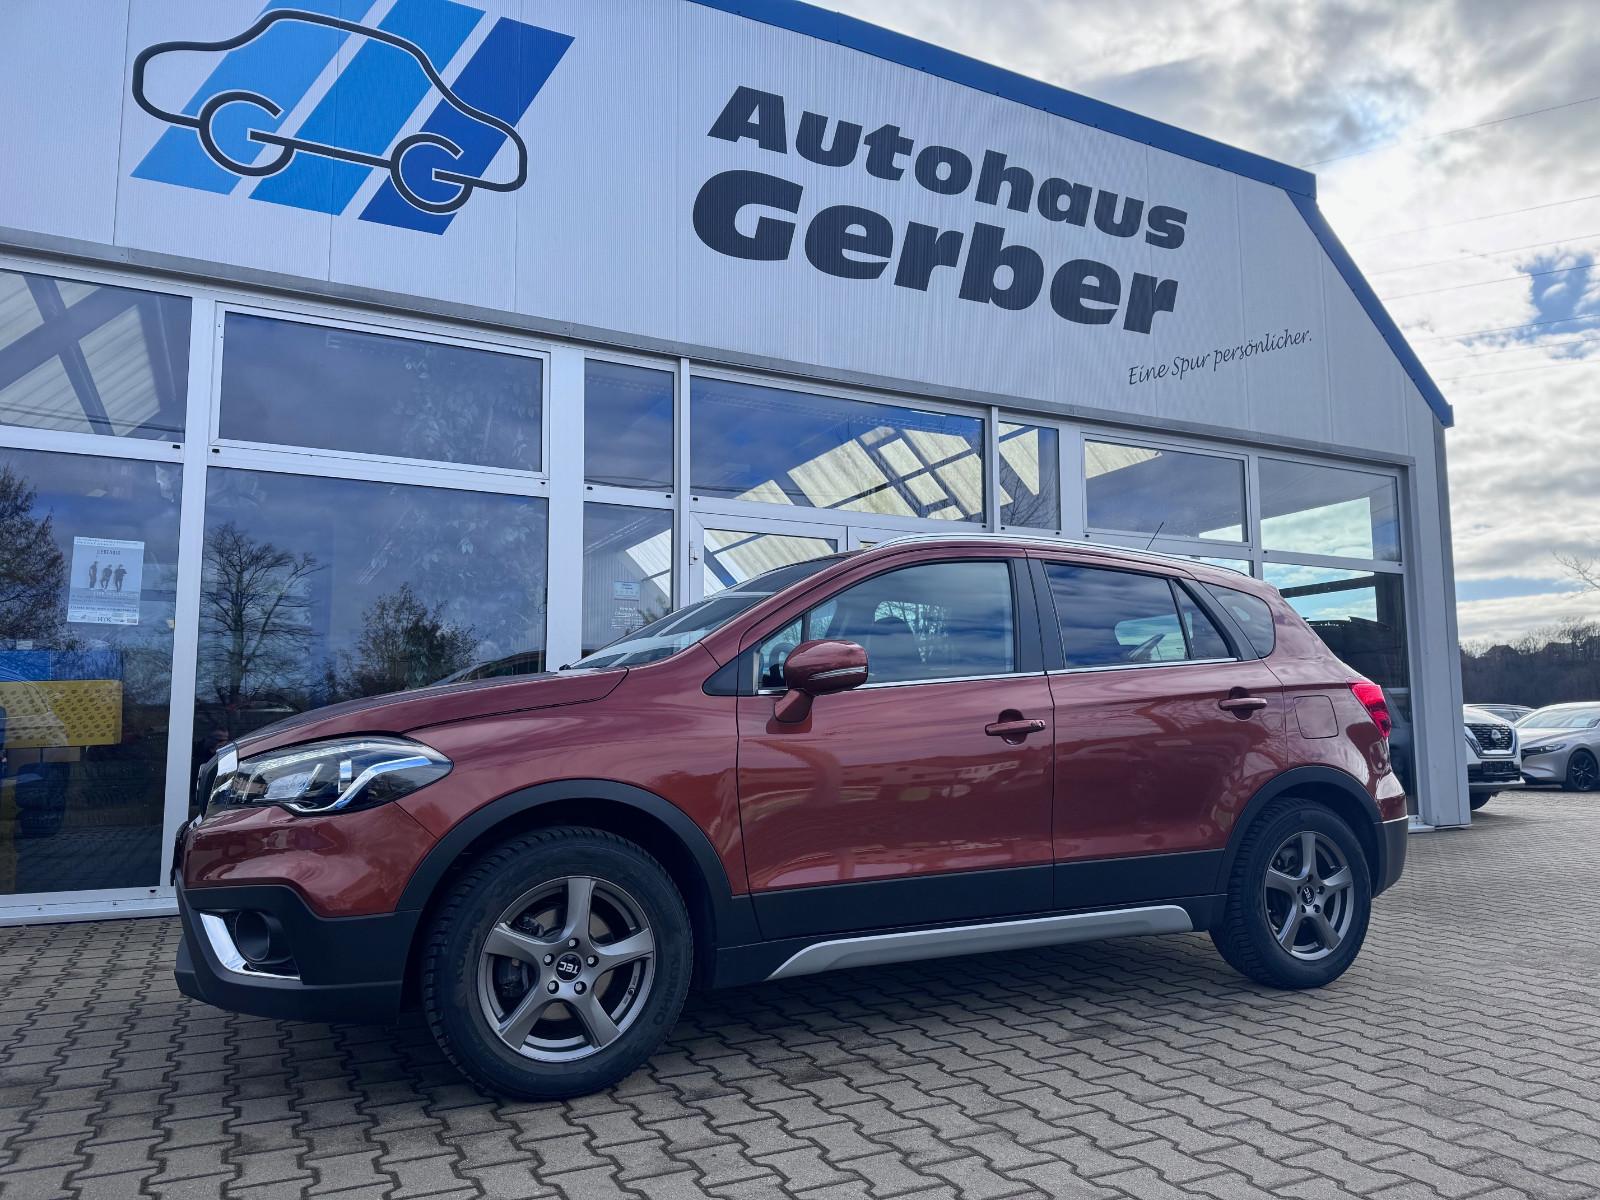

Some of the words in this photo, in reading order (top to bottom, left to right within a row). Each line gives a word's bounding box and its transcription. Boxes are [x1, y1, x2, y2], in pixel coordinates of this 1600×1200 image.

[706, 85, 1188, 250] Autohaus
[692, 169, 1179, 335] Gerber
[1128, 364, 1169, 385] Eine
[1172, 352, 1211, 380] Spur
[1213, 328, 1312, 372] persönlicher.
[558, 961, 579, 975] TEC
